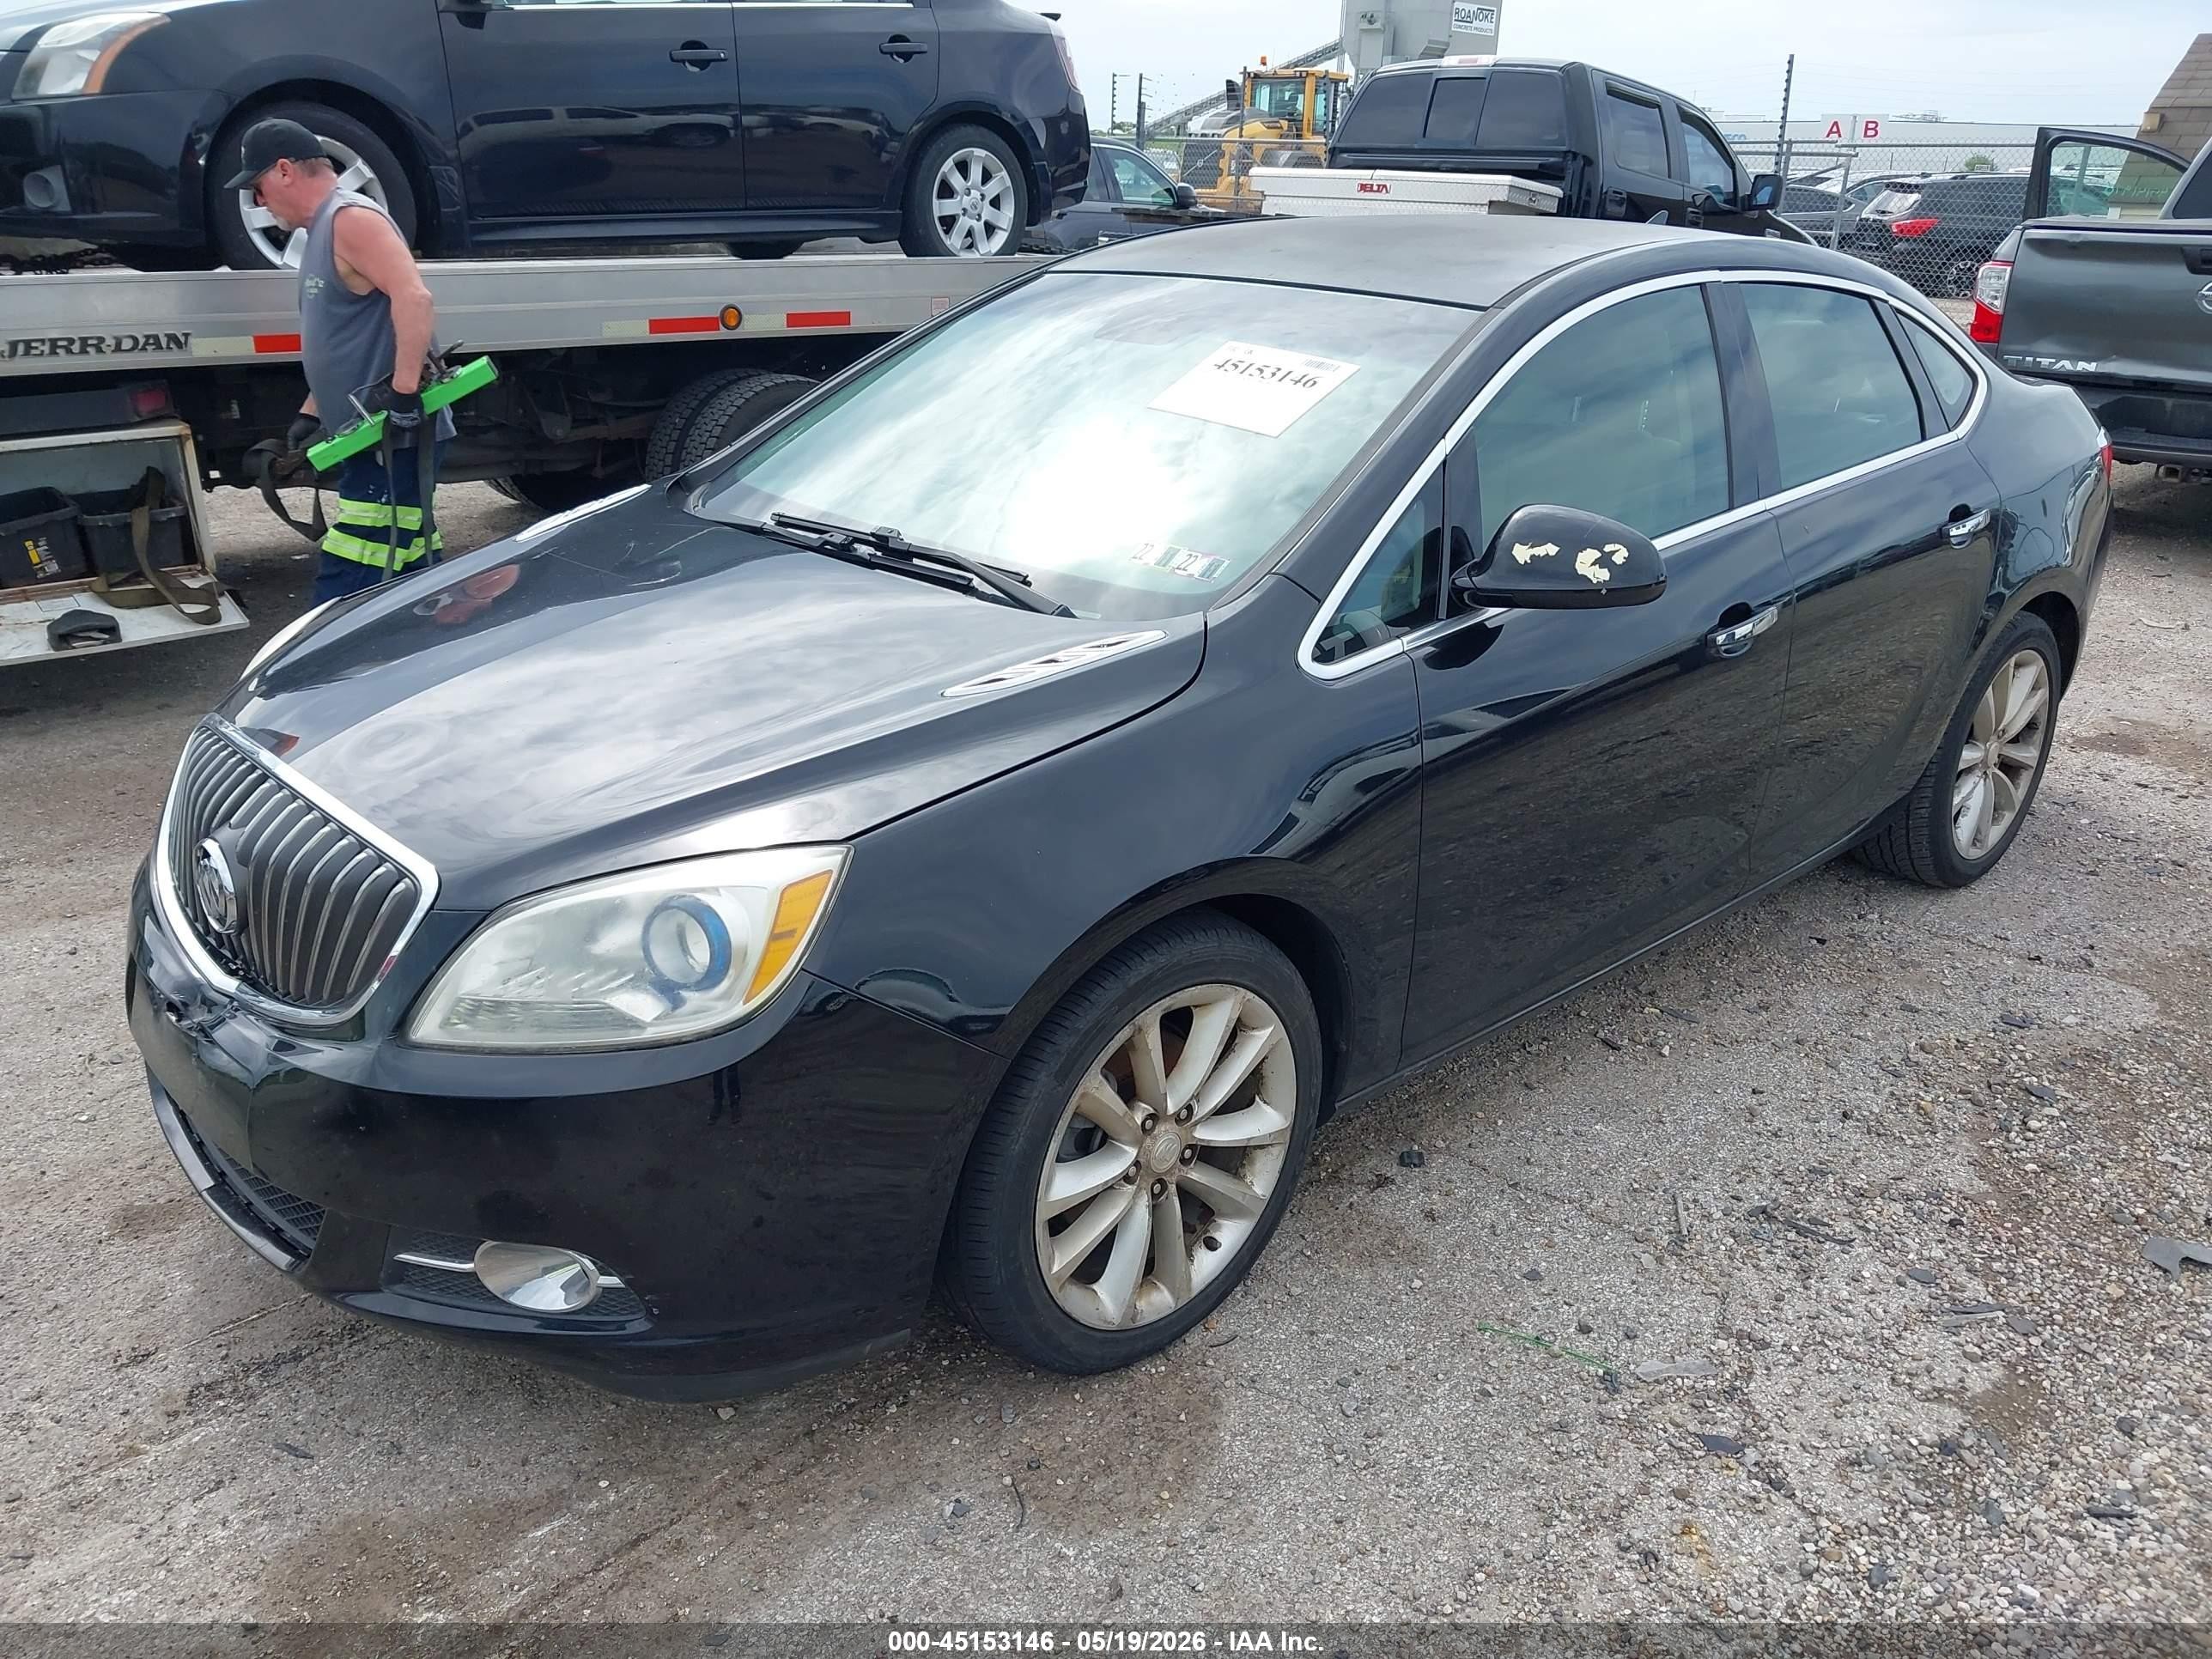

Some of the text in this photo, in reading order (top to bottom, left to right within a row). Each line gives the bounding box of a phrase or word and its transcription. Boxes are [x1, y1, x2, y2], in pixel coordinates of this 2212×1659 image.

[1455, 7, 1495, 23] ROANOKE
[1826, 120, 1842, 138] A
[1863, 120, 1879, 138] B
[7, 332, 192, 359] JERR-DAN
[2002, 355, 2098, 372] TITAN
[1213, 358, 1324, 389] 45153146
